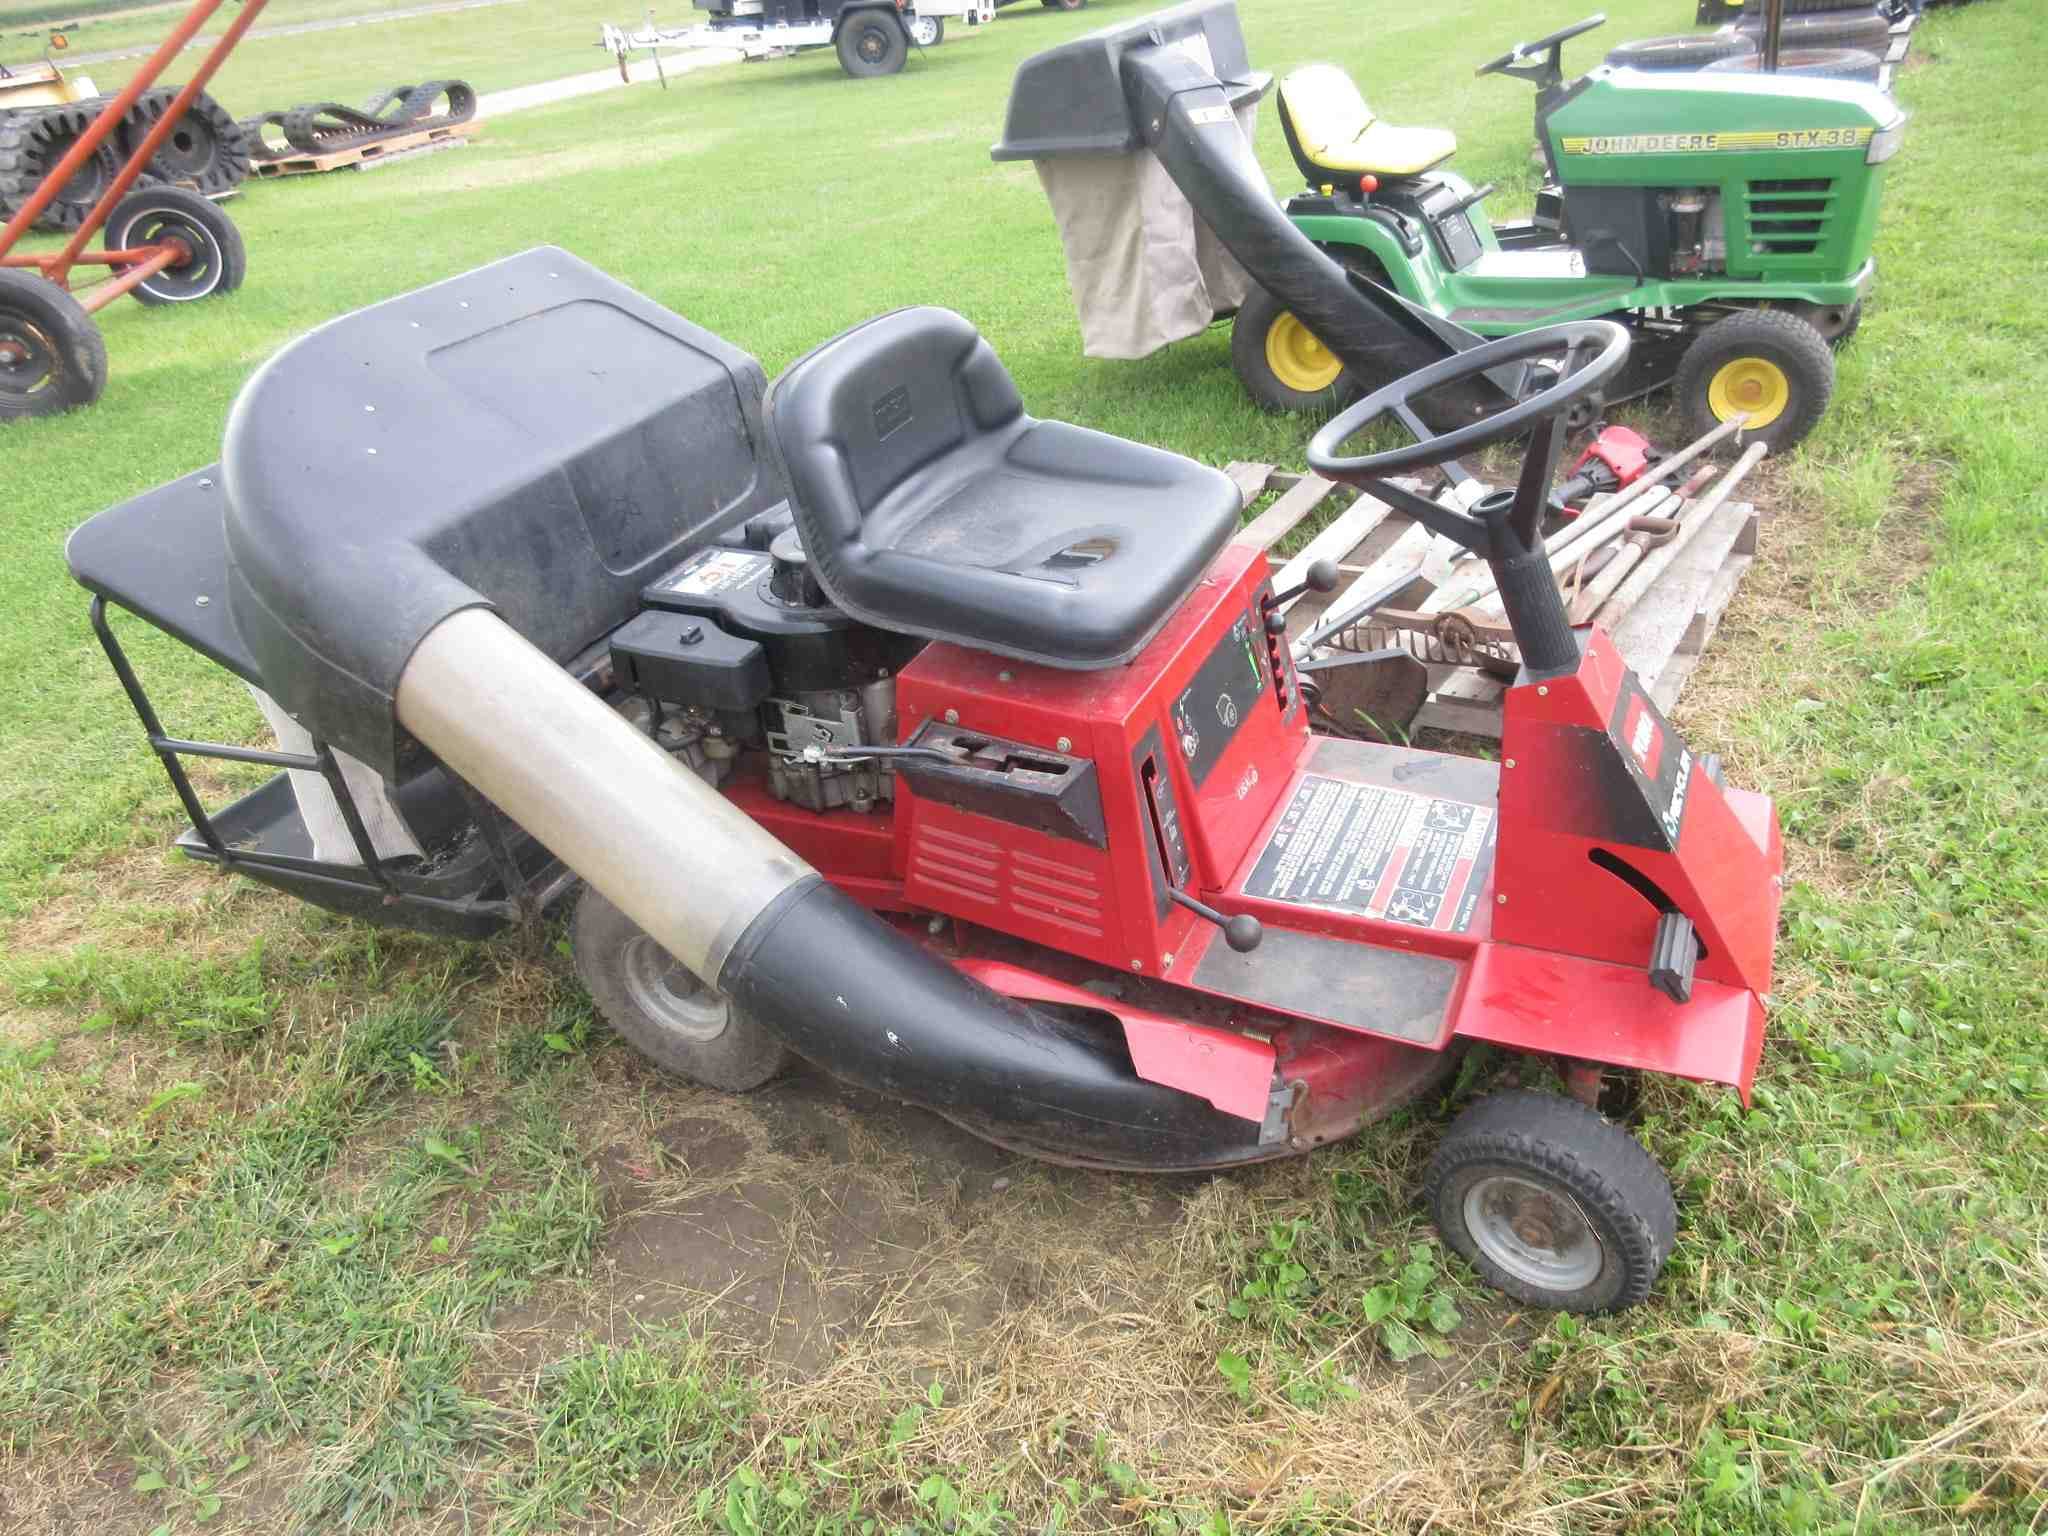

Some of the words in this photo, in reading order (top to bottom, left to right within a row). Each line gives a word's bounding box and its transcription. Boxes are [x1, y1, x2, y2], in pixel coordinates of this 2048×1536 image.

[1582, 137, 1639, 154] JOHN
[1644, 134, 1719, 151] DEERE
[1776, 130, 1821, 148] STX
[1825, 128, 1857, 146] 38
